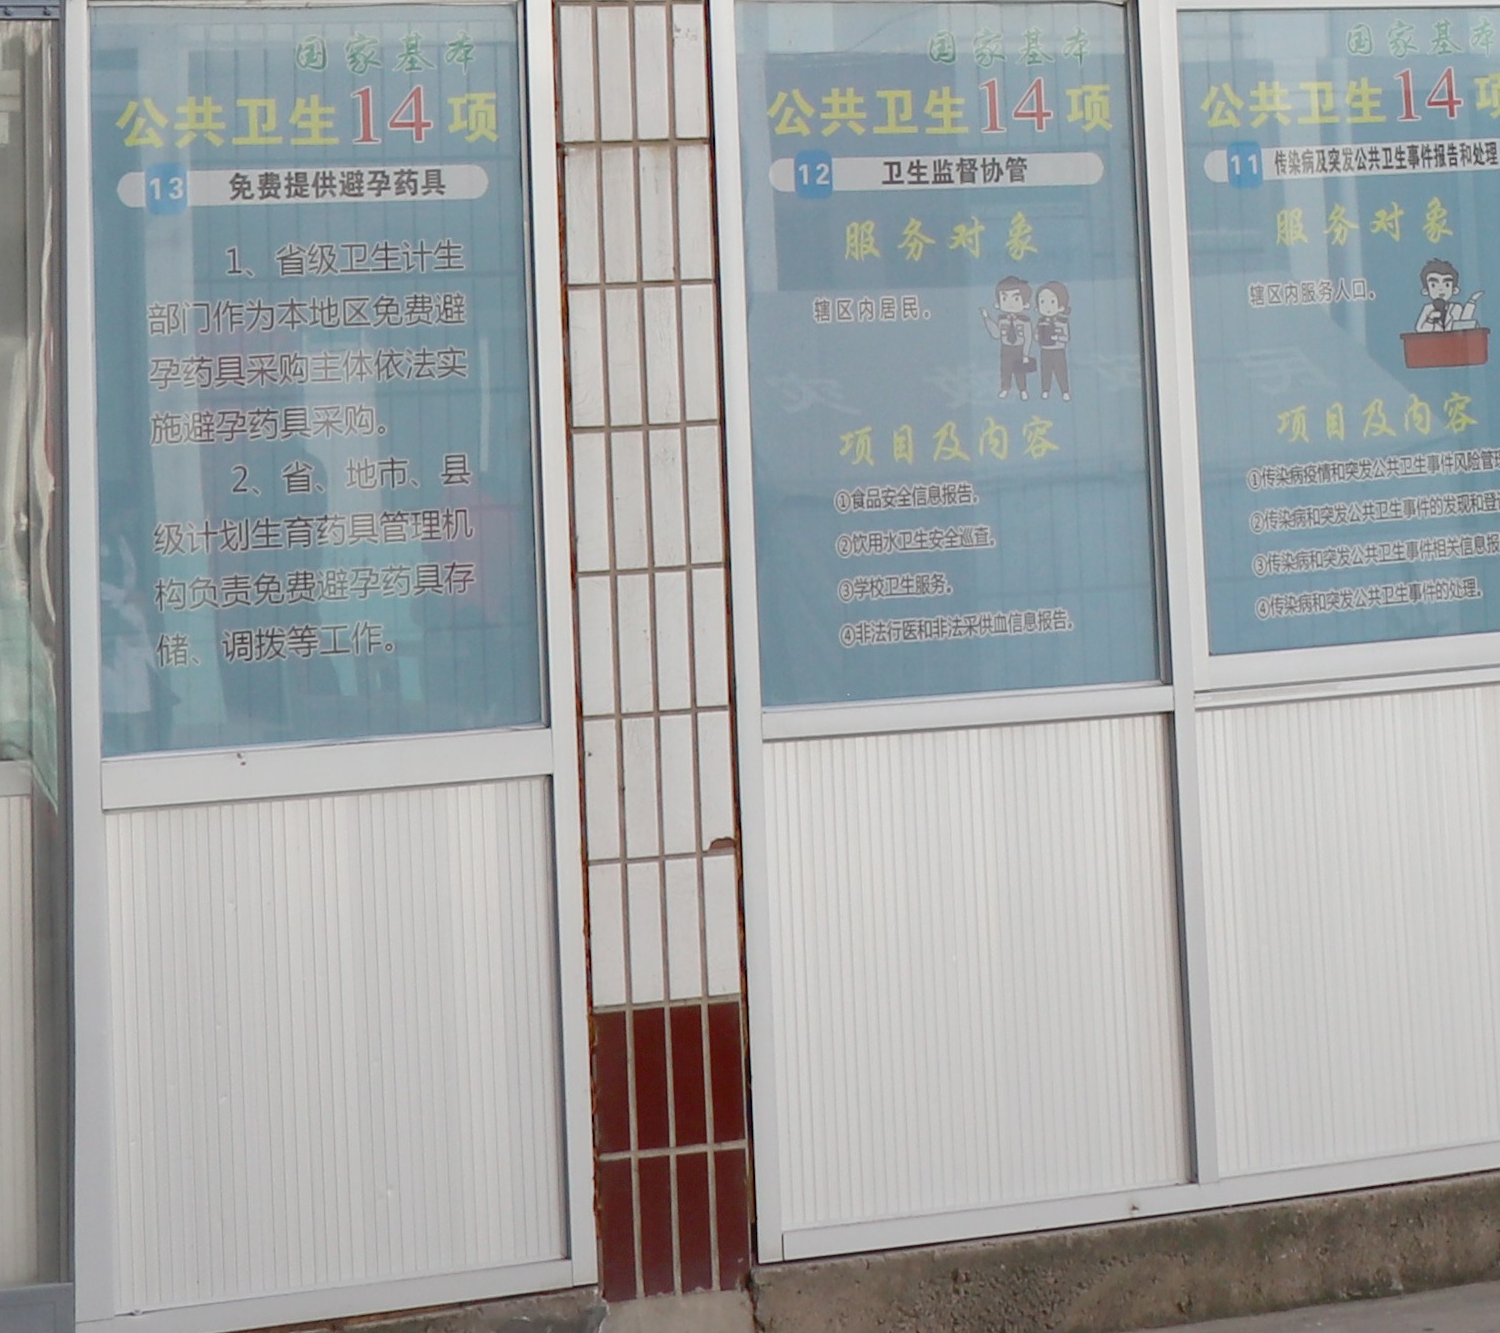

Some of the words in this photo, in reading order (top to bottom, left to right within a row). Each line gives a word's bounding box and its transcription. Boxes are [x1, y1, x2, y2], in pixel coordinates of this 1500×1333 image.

[295, 30, 475, 74] 国家基本
[927, 30, 1091, 67] 国家基本
[1346, 18, 1496, 57] 国家基本
[117, 84, 499, 150] 公共卫生14项
[767, 75, 1113, 136] 公共卫生14项
[798, 163, 830, 186] 12
[881, 158, 1028, 184] 卫生监督协管
[1230, 155, 1259, 175] 11
[1275, 145, 1498, 175] 传染病及突发公共卫生事件报告和处理
[150, 174, 184, 202] 13
[228, 169, 446, 200] 免费提供避孕药具
[844, 212, 1039, 261] 服务对象
[1276, 197, 1454, 246] 服务对象
[812, 295, 931, 322] 辖区内居民。
[1249, 279, 1376, 306] 辖区内服务人口。
[147, 293, 466, 336] 部门作为本地区免费避
[150, 349, 468, 390] 孕药具采购主体依法实
[150, 406, 388, 445] 施避孕药具采购。
[1277, 393, 1478, 443] 项目及内容
[839, 415, 1059, 465] 项目及内容
[154, 510, 473, 557] 级计划生育药具管理机
[154, 561, 475, 612] 构负责免费避孕药具存
[157, 626, 396, 668] 储、调拨等工作。
